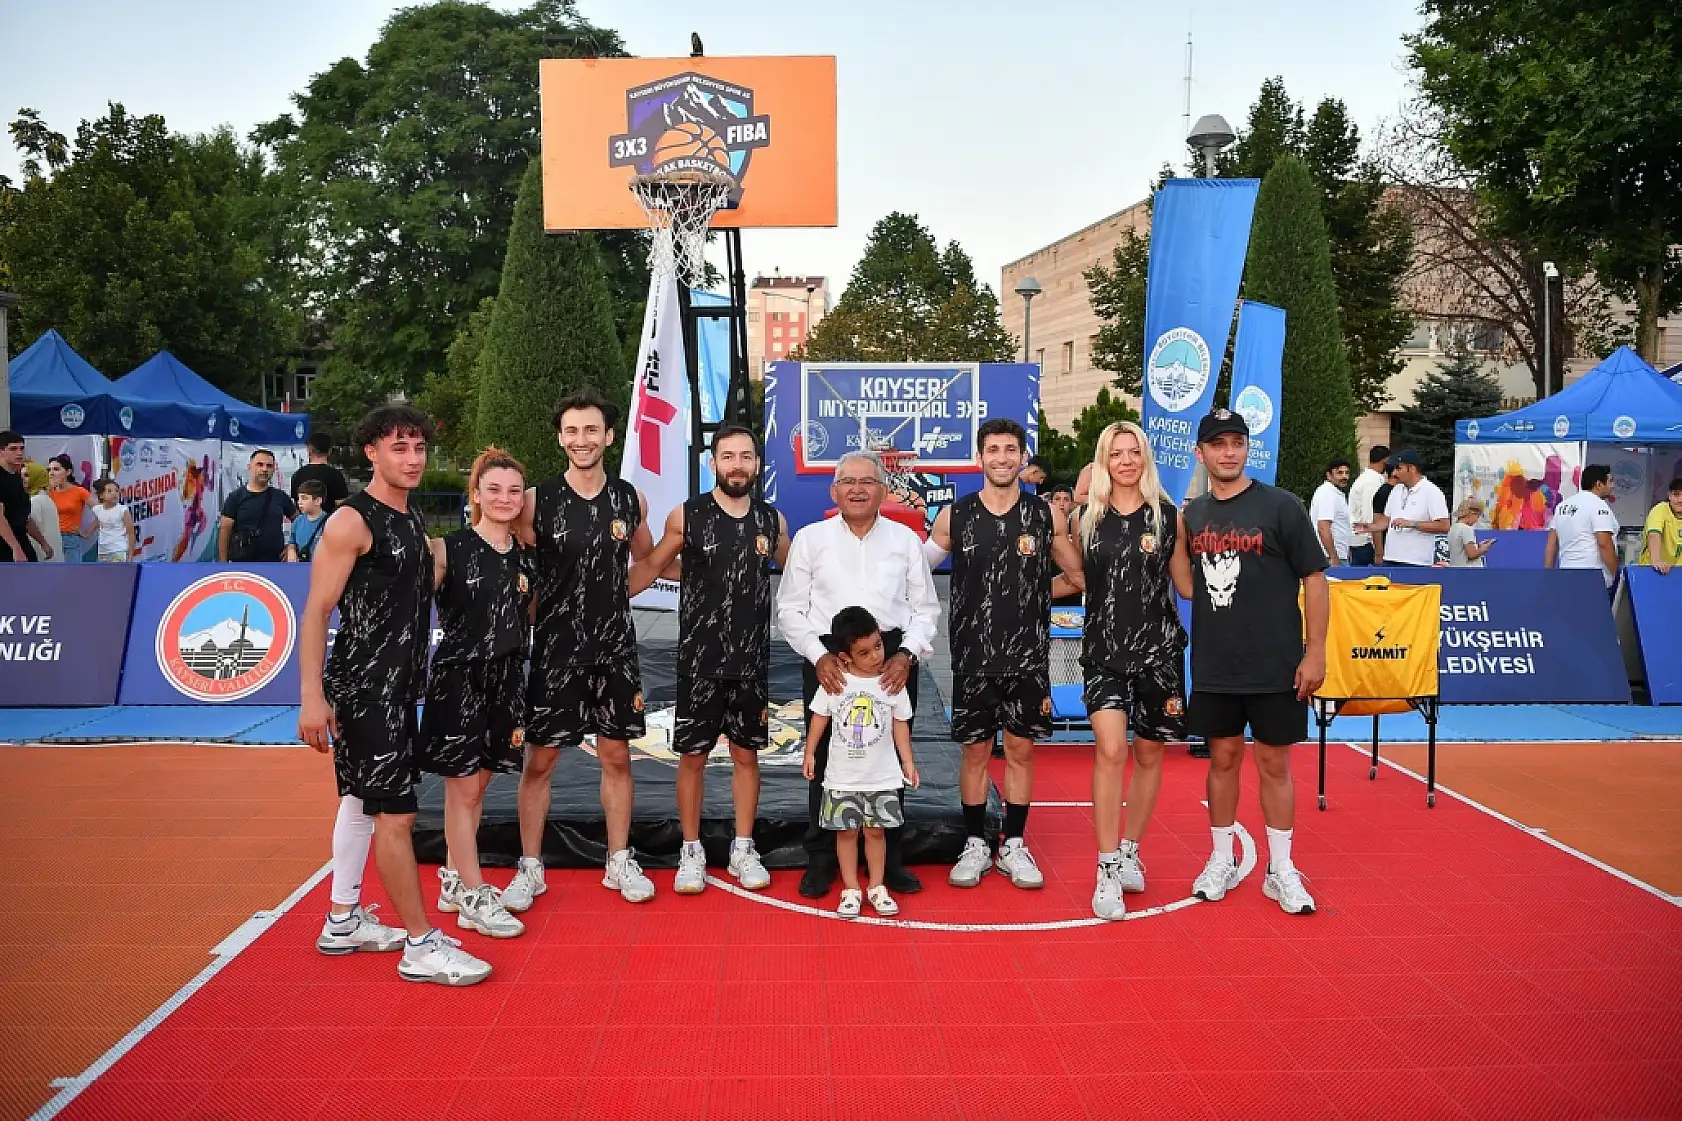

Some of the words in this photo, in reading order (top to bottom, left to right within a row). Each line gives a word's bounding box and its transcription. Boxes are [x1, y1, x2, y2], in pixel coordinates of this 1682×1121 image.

[727, 122, 768, 145] FIBA
[614, 137, 647, 159] 3X3
[926, 488, 954, 503] FIBA
[20, 615, 52, 635] VE
